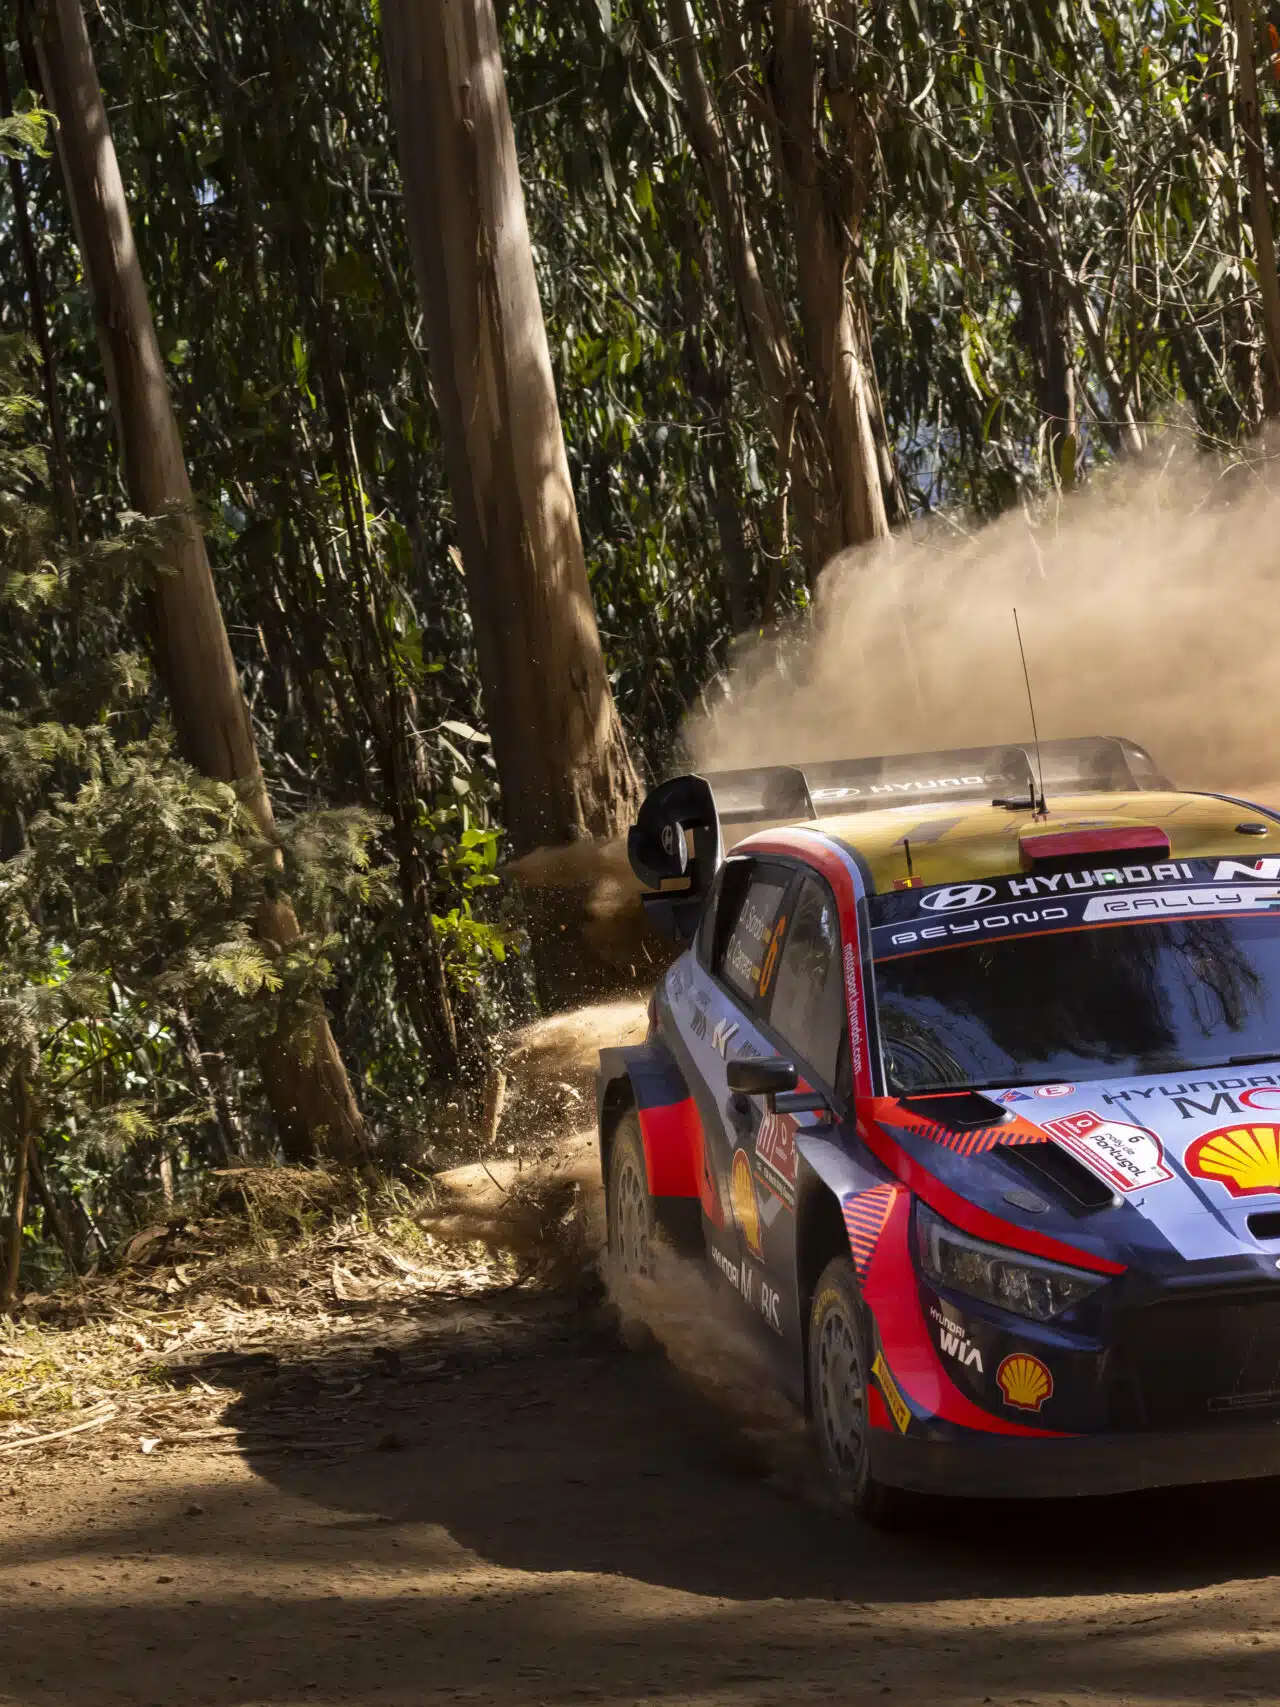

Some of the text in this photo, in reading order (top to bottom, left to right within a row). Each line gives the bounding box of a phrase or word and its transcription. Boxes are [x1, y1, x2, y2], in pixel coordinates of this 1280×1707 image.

[1008, 863, 1193, 896] HYUNDAI
[891, 893, 1242, 945] BEYOND RALLY
[843, 942, 863, 1076] motorsport.hyundai.com
[1089, 1135, 1148, 1177] Portugal
[1104, 1133, 1135, 1155] rally de
[1128, 1135, 1146, 1143] 6
[740, 1259, 783, 1335] MBIS
[930, 1306, 965, 1338] HYUNDAI
